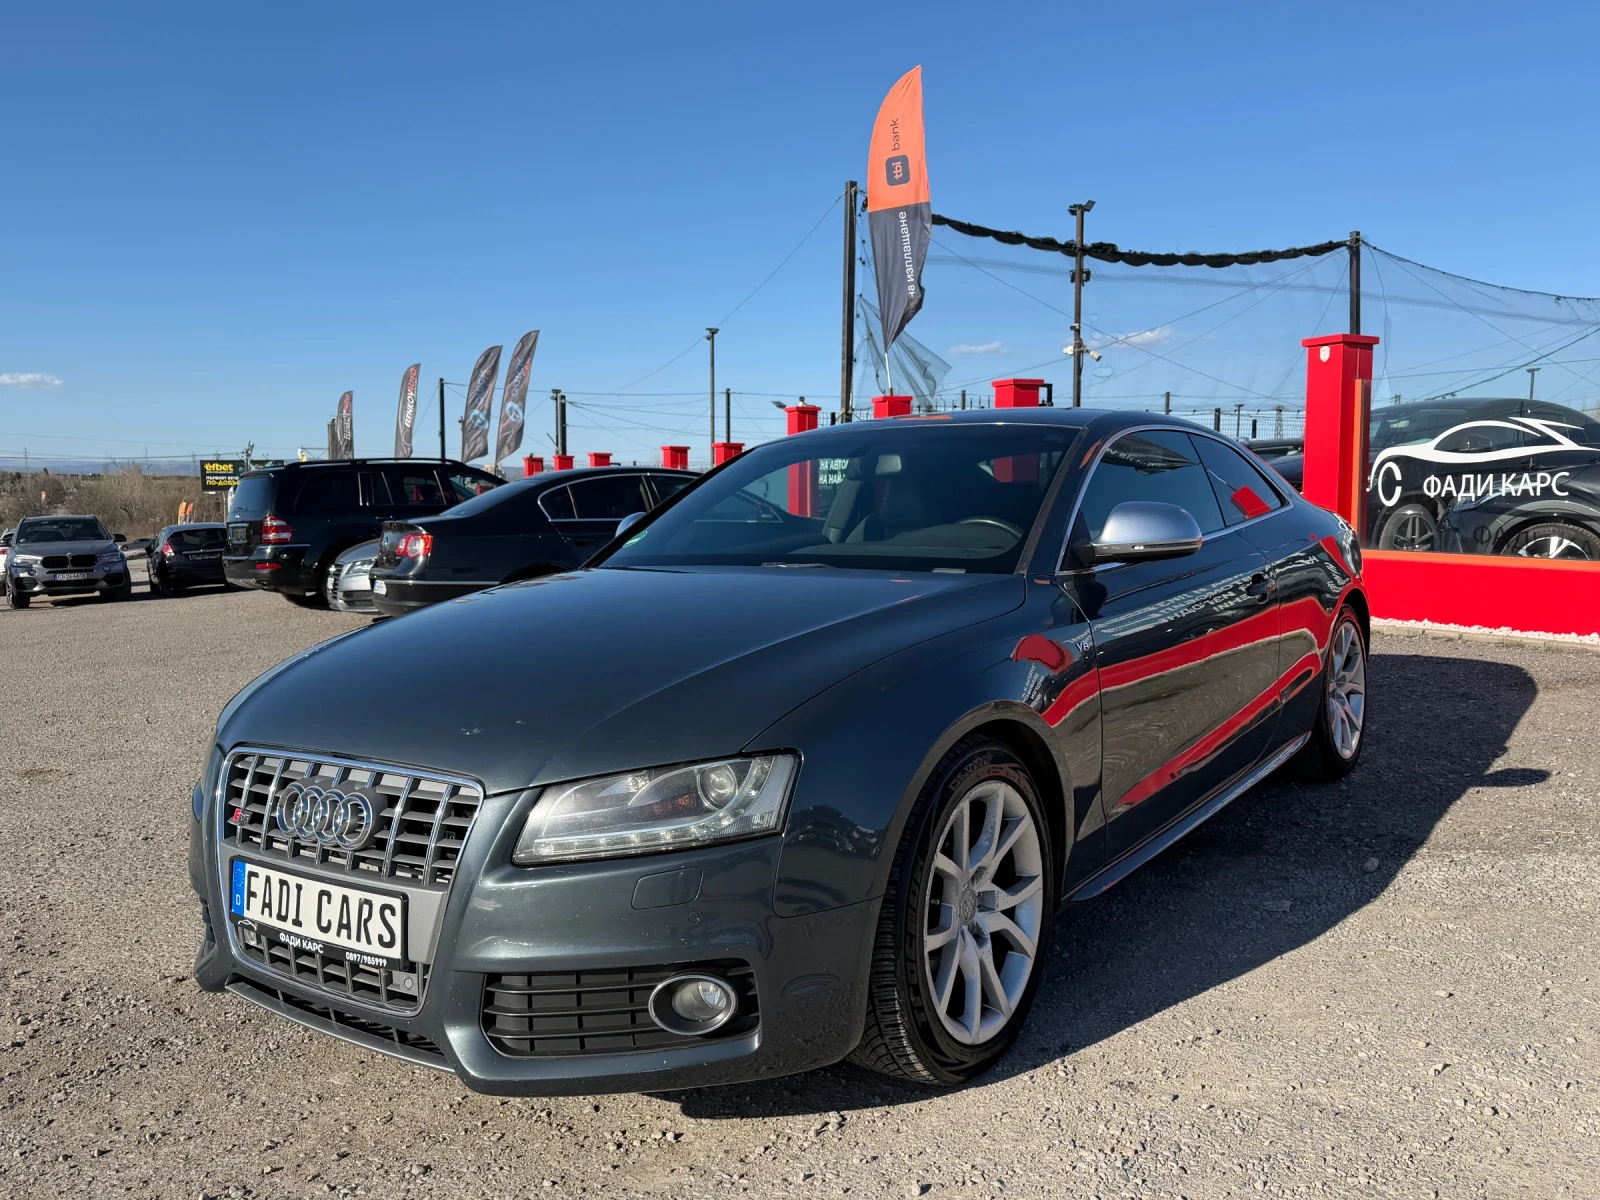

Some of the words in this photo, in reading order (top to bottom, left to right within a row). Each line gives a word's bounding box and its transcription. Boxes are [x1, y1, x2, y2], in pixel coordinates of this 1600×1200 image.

[890, 118, 901, 151] bank
[892, 161, 903, 180] tbi
[899, 211, 914, 282] изплащане
[205, 462, 233, 471] efbet
[1423, 473, 1494, 501] ФАДИ
[1501, 471, 1570, 497] КАРС
[235, 893, 242, 906] D
[245, 870, 303, 928] FADI
[316, 889, 397, 949] CARS
[279, 932, 301, 948] ФАДИ
[302, 940, 324, 954] КАРС
[345, 951, 387, 968] 0897/985999
